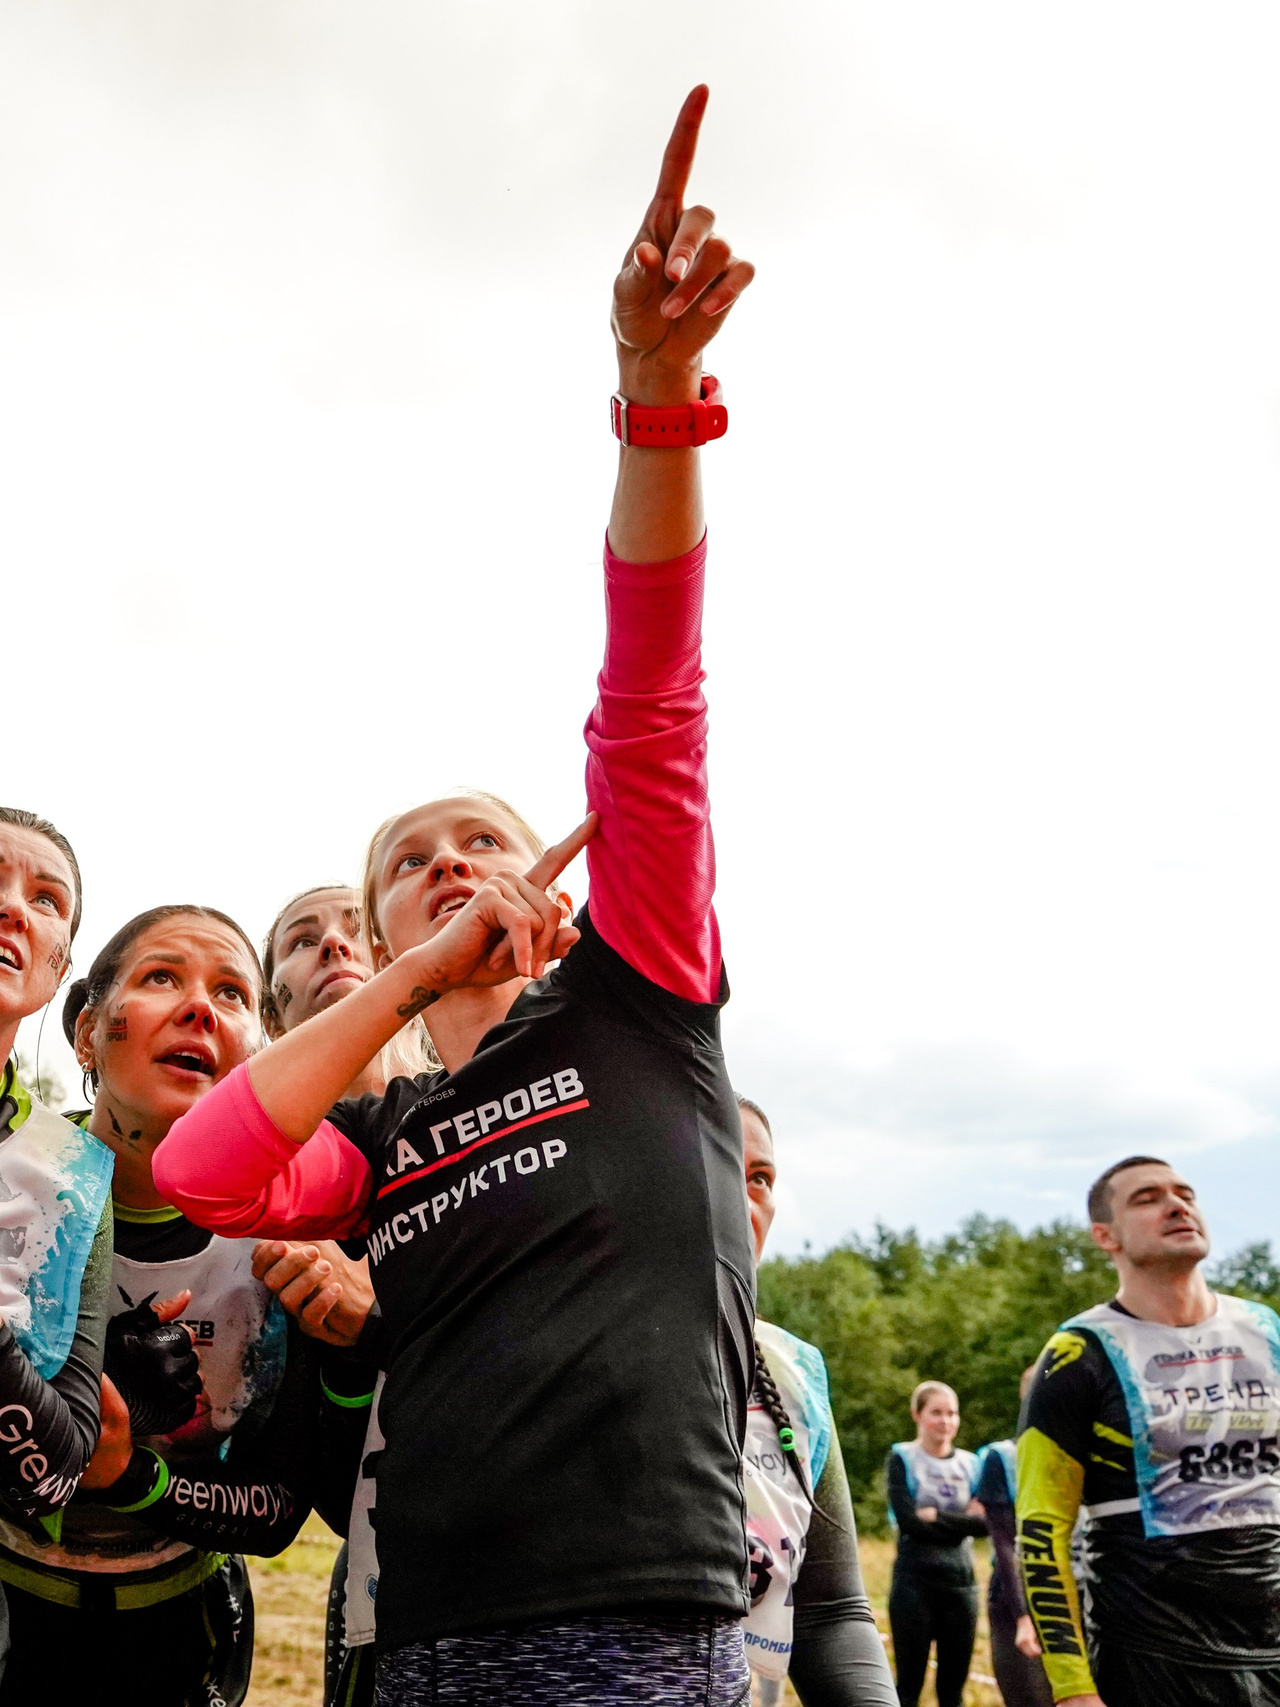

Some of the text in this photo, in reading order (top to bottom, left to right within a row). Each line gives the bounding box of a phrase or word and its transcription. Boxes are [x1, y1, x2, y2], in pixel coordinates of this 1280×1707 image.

[416, 1087, 458, 1109] ГЕРОЕВ
[428, 1066, 586, 1157] ГЕРОЕВ
[365, 1137, 569, 1267] ИНСТРУКТОР
[163, 1474, 281, 1527] reenway
[1021, 1518, 1083, 1656] VENUM
